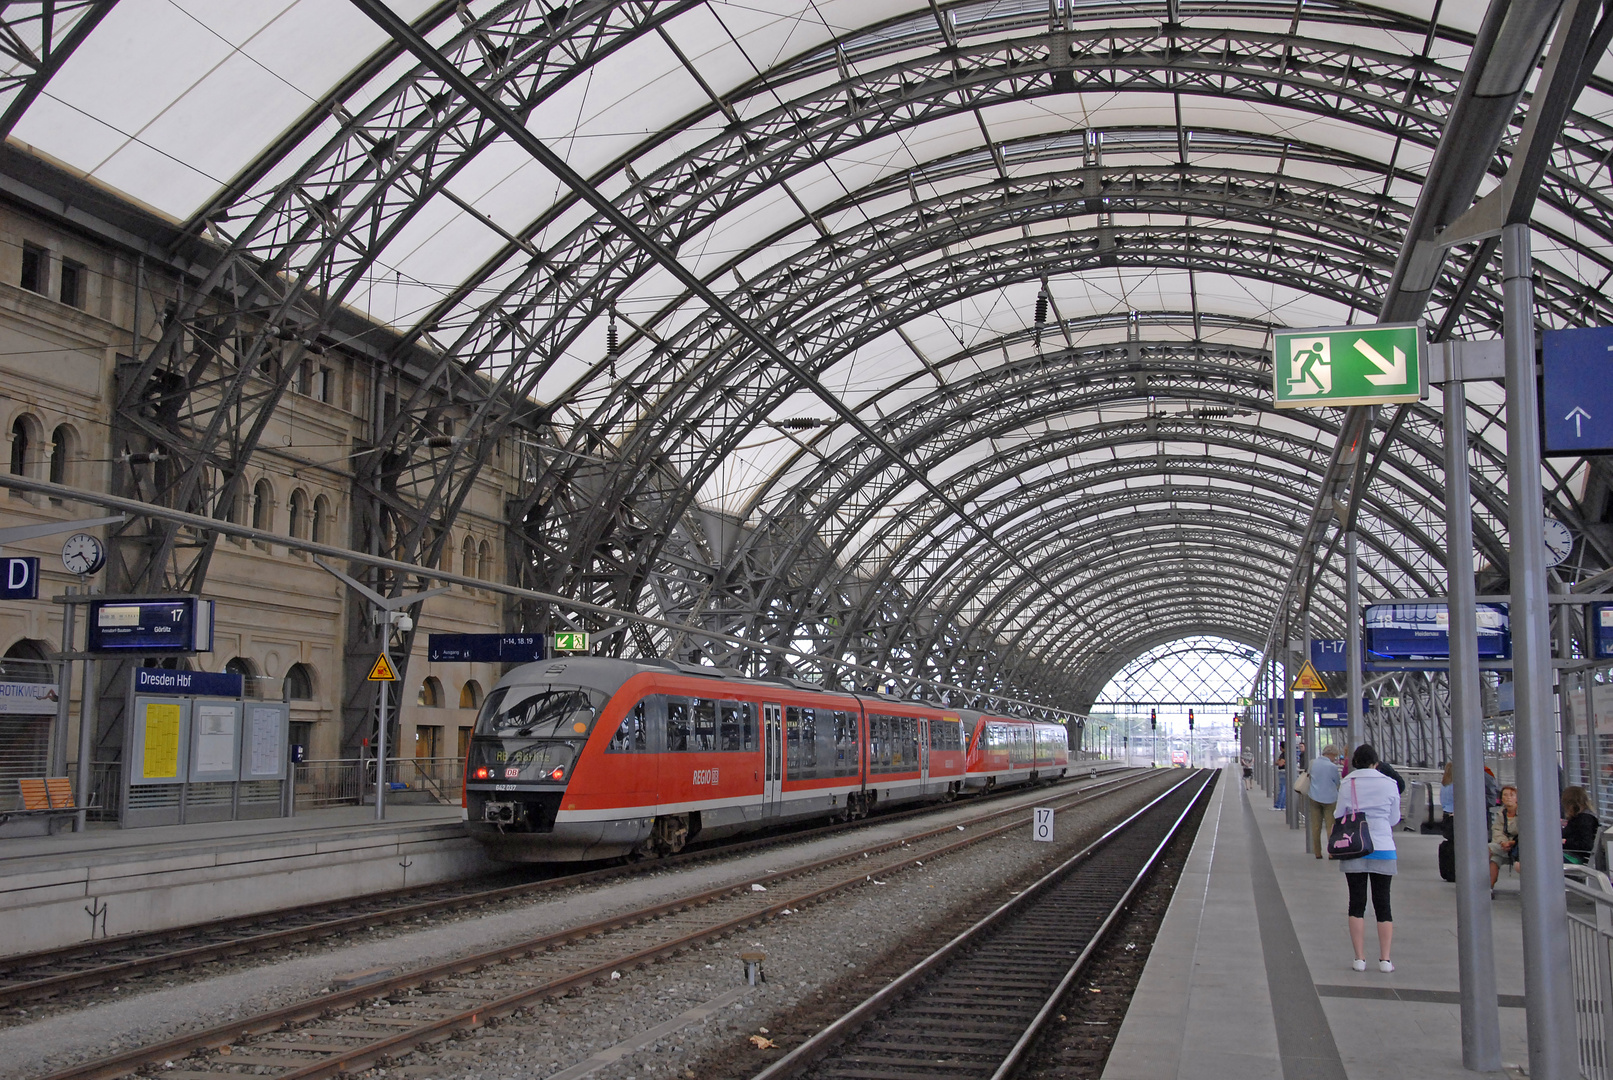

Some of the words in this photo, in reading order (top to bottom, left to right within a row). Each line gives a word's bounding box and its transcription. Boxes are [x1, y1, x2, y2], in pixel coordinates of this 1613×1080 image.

[8, 559, 29, 589] D
[171, 609, 184, 622] 17
[1318, 640, 1346, 653] 1-17
[140, 672, 175, 686] Dresden
[176, 674, 192, 687] Hbf
[496, 751, 508, 761] RB
[692, 769, 711, 785] REGIO
[1037, 810, 1050, 823] 17
